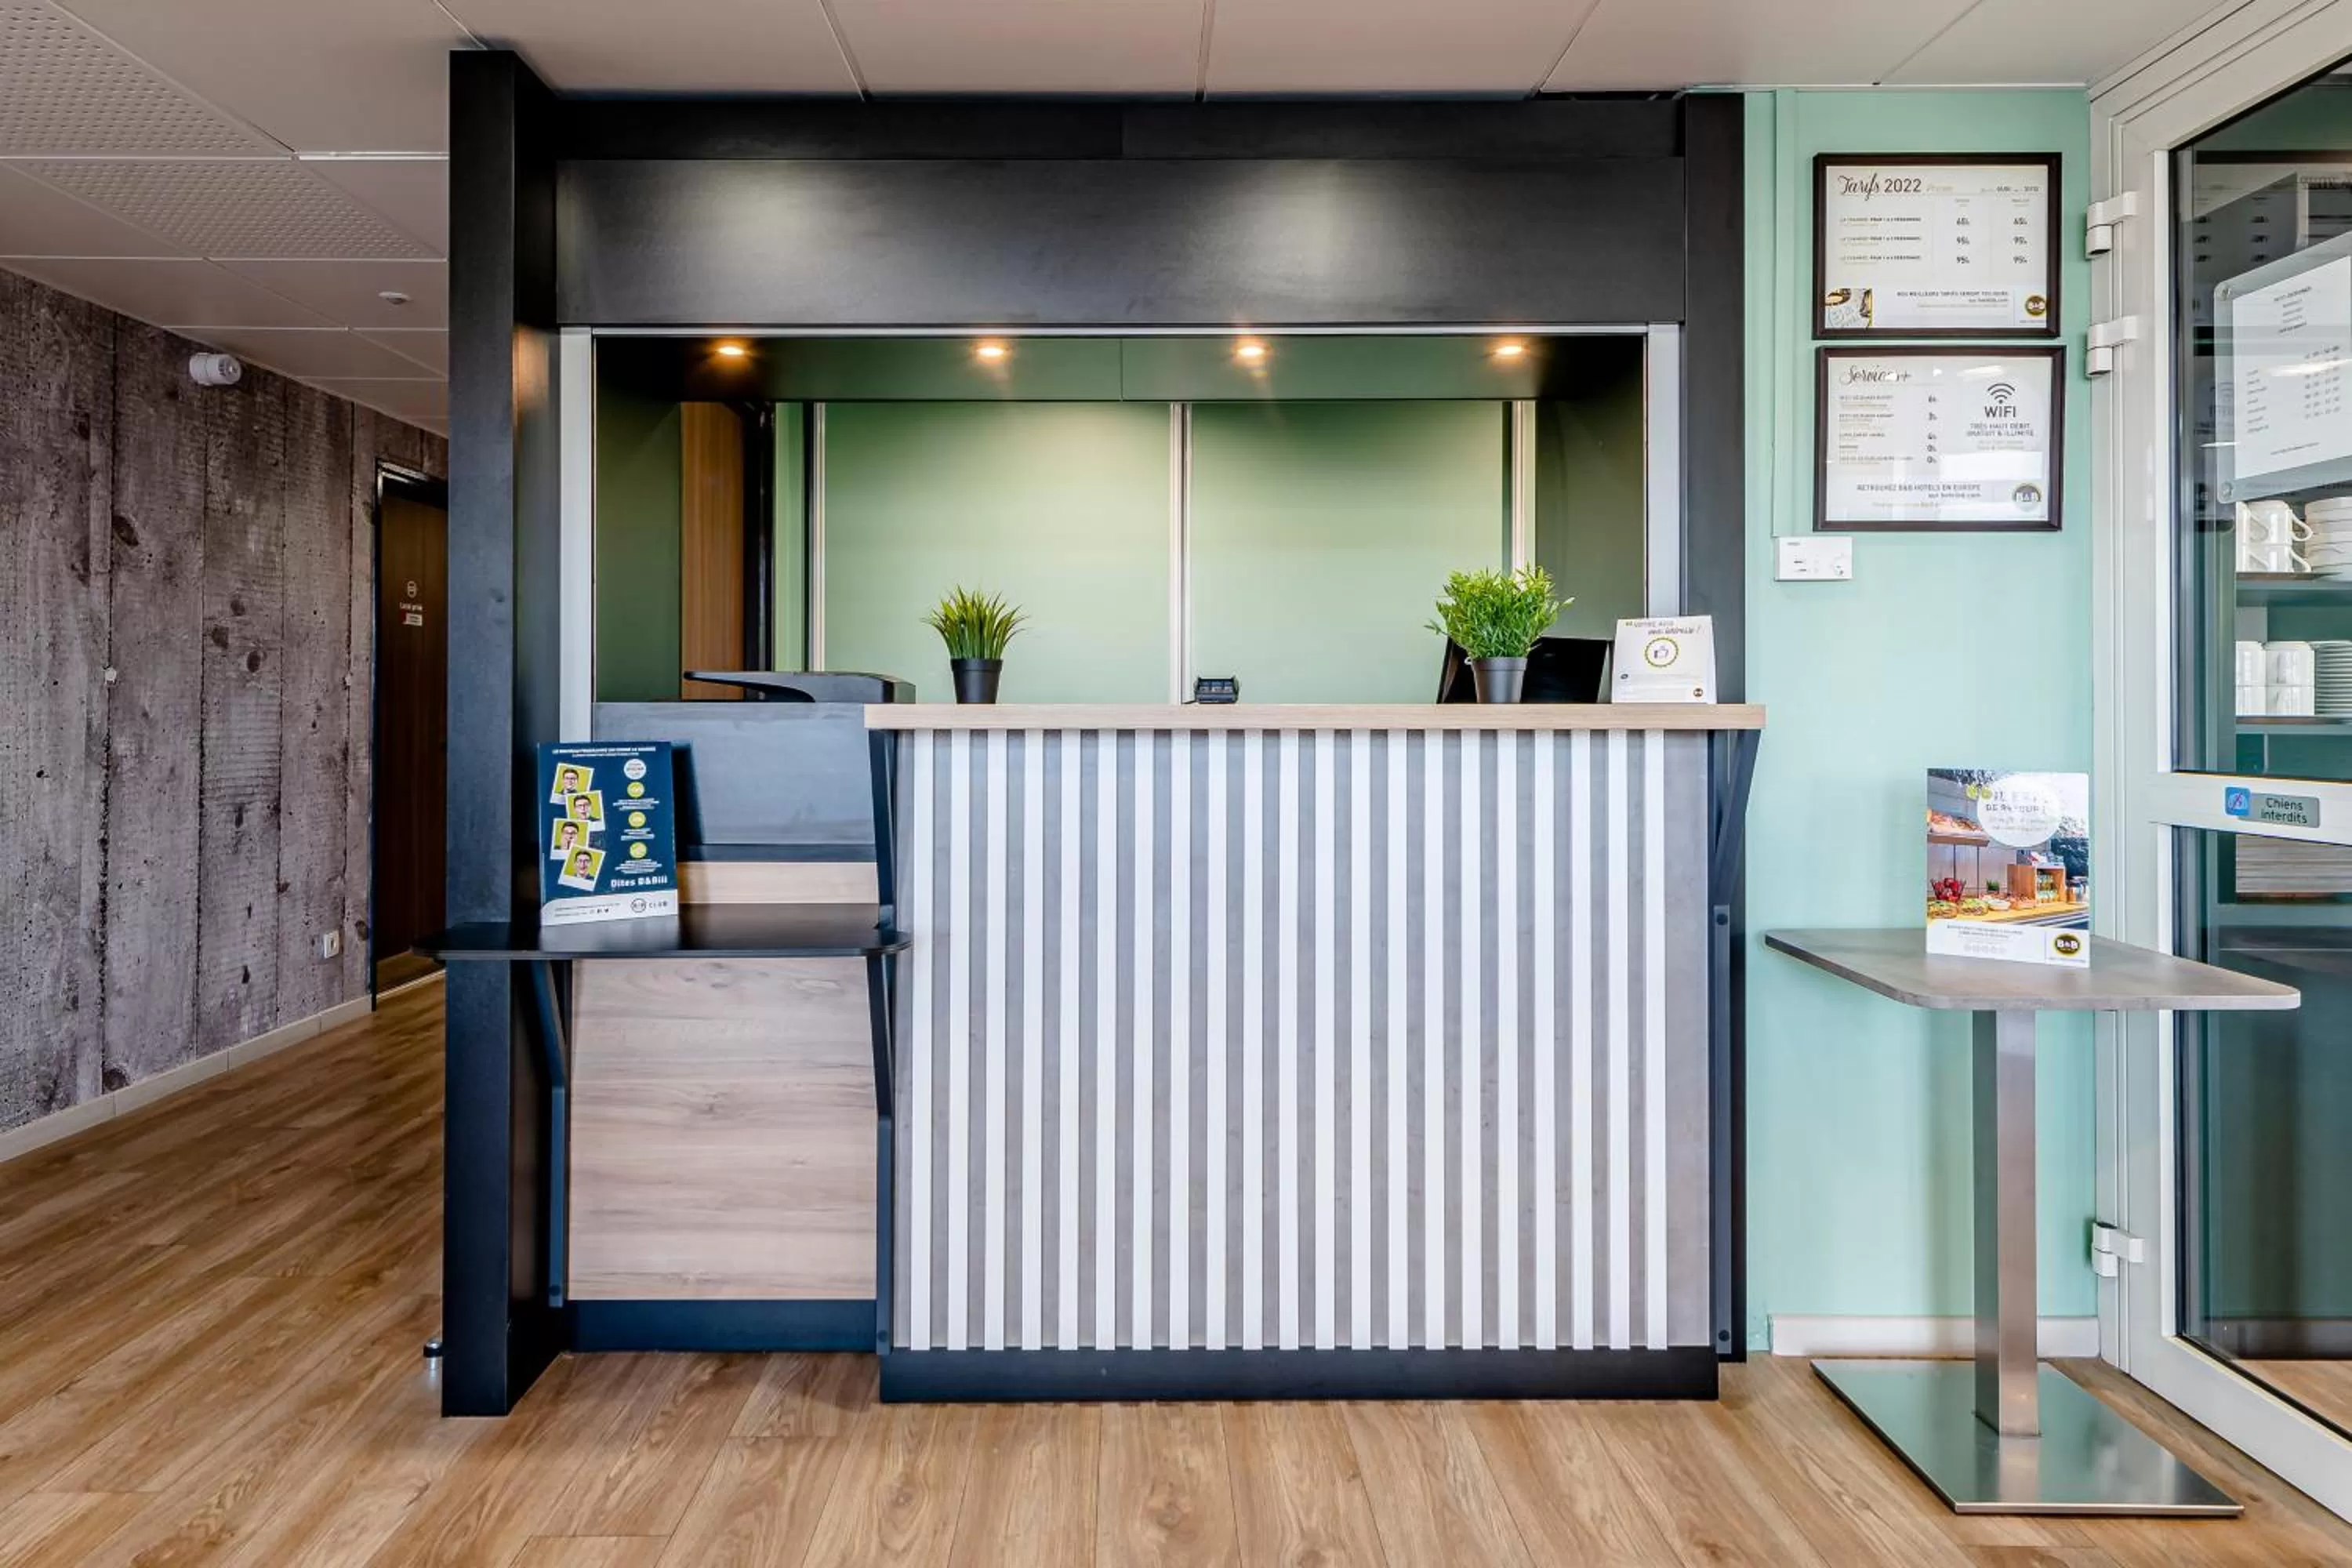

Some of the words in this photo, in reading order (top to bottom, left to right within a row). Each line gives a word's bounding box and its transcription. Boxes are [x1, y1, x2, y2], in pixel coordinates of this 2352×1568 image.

[1838, 172, 1879, 201] Tarifs
[1884, 178, 1922, 193] 2022
[1984, 405, 2016, 418] WIFI
[2265, 797, 2303, 811] Chiens
[2260, 809, 2307, 823] interdits
